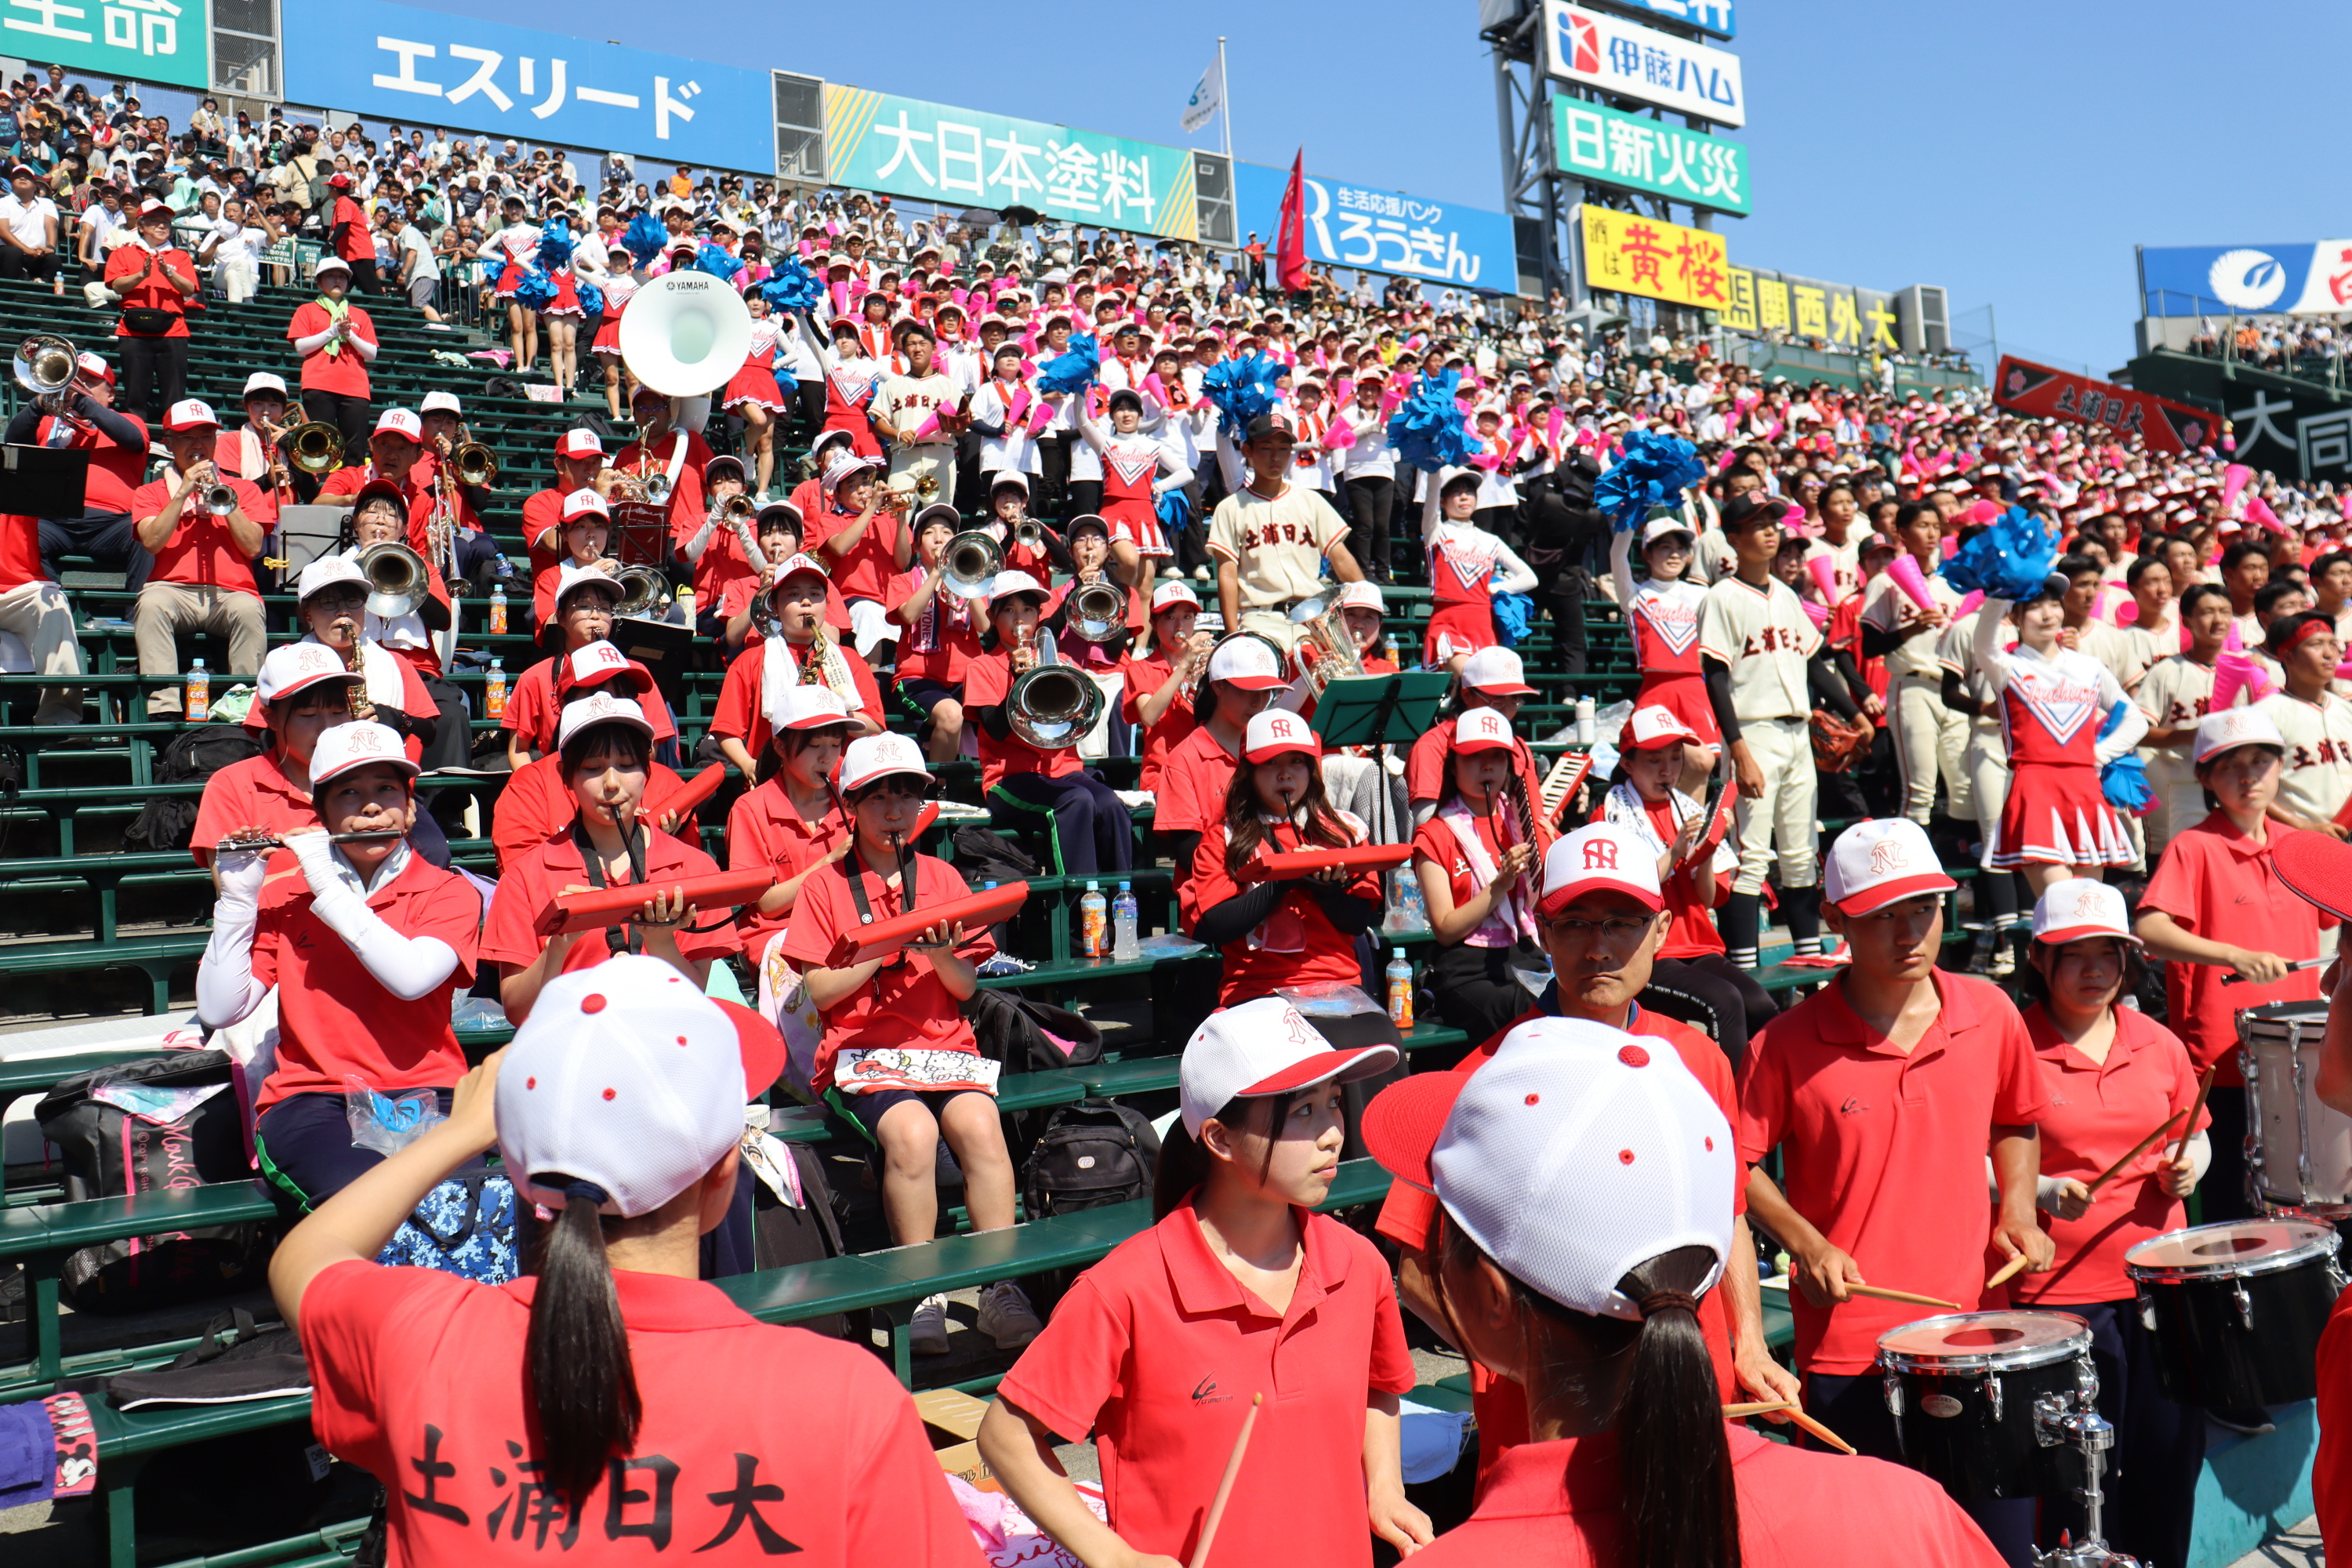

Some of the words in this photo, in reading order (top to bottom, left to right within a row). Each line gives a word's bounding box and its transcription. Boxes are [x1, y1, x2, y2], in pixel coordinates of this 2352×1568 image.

[372, 35, 702, 140] エスリード
[1609, 36, 1736, 107] 伊藤ハム
[874, 110, 1156, 225] 大日本塗料
[1566, 107, 1742, 204] 日新火災
[1338, 187, 1443, 224] 生活応援バンク
[1339, 211, 1481, 283] ろうきん
[1621, 223, 1726, 303] 黄桜
[676, 281, 710, 290] YAMAHA
[2055, 383, 2146, 436] 土浦日大
[1244, 523, 1319, 550] 土浦日大
[2022, 673, 2101, 706] Tsuchiura
[403, 1423, 804, 1555] 土浦日大
